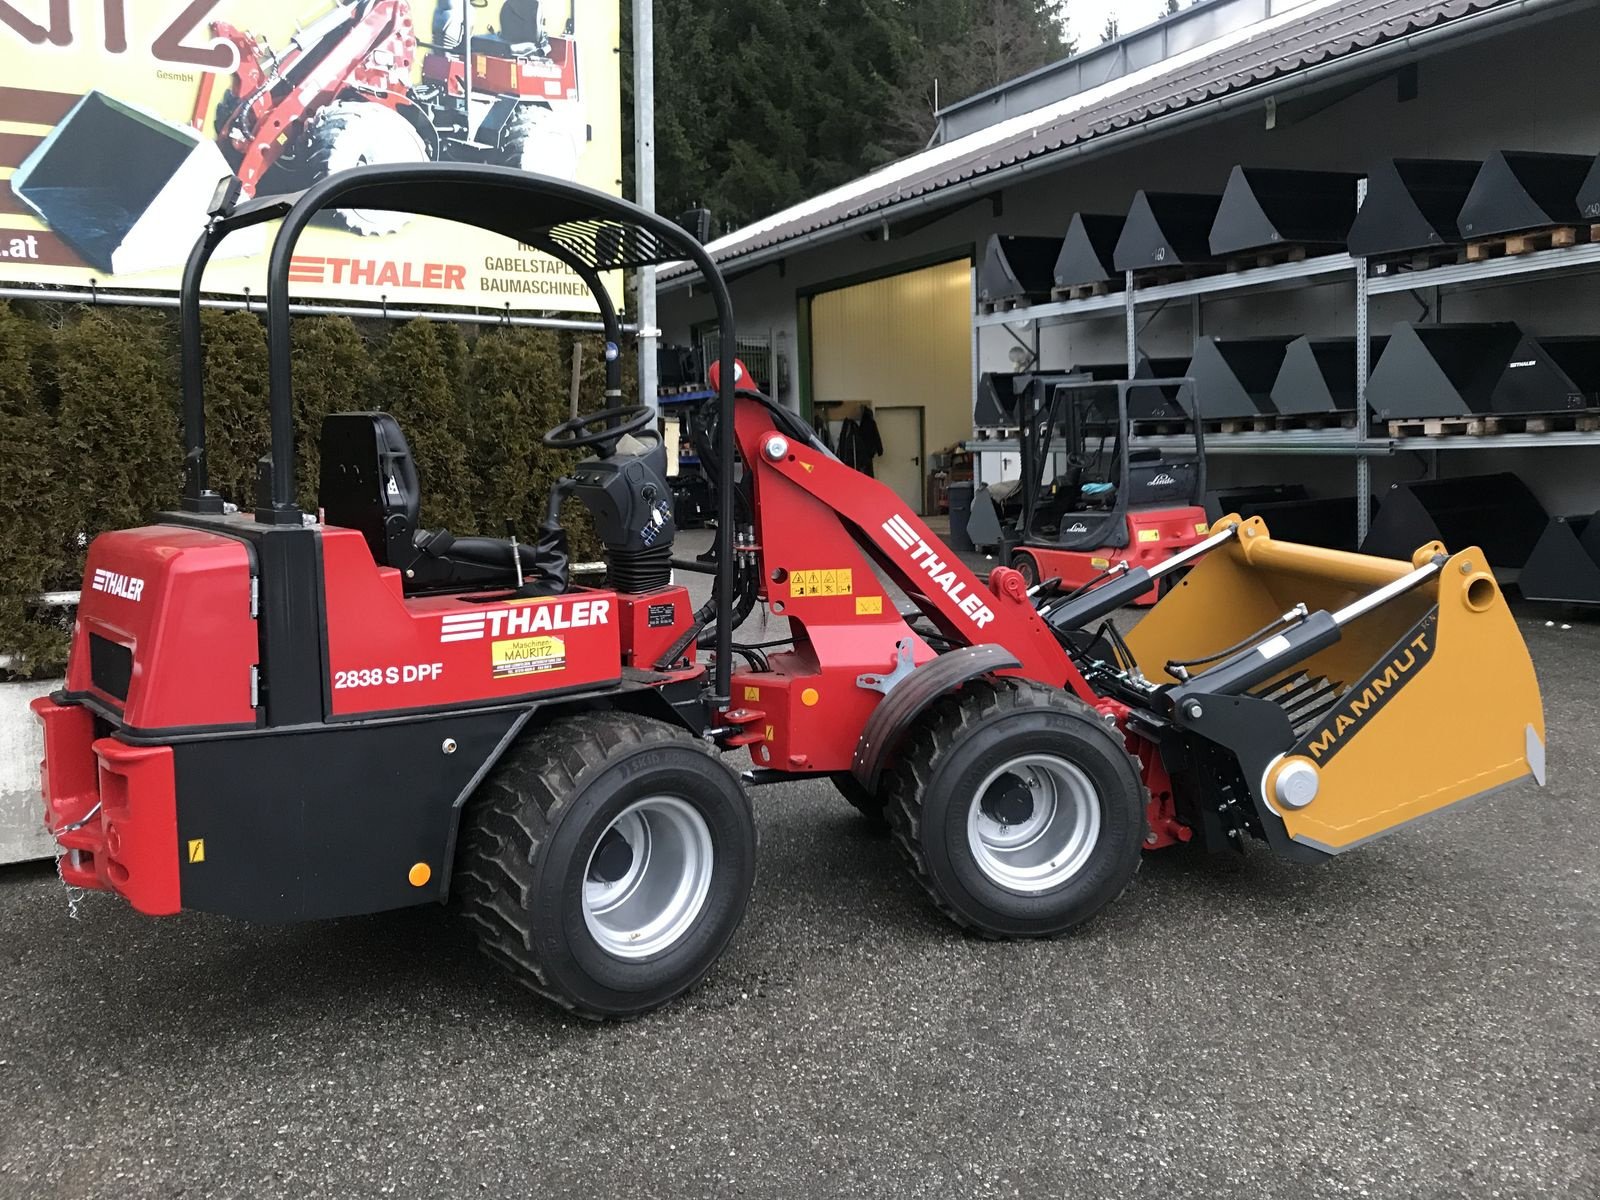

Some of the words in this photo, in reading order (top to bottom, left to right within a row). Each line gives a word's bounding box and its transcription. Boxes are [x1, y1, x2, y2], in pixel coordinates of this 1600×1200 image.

[156, 69, 194, 82] GesmbH
[0, 234, 39, 259] .at
[326, 257, 467, 290] THALER
[480, 277, 590, 297] BAUMASCHINEN
[1146, 473, 1176, 486] Linde
[1066, 522, 1088, 533] Linde
[103, 570, 145, 602] THALER
[909, 539, 995, 629] THALER
[484, 600, 610, 637] THALER
[504, 645, 553, 661] MAURITZ
[334, 668, 384, 689] 2838
[385, 666, 400, 685] S
[402, 662, 443, 683] DPF
[1308, 632, 1430, 759] MAMMUT
